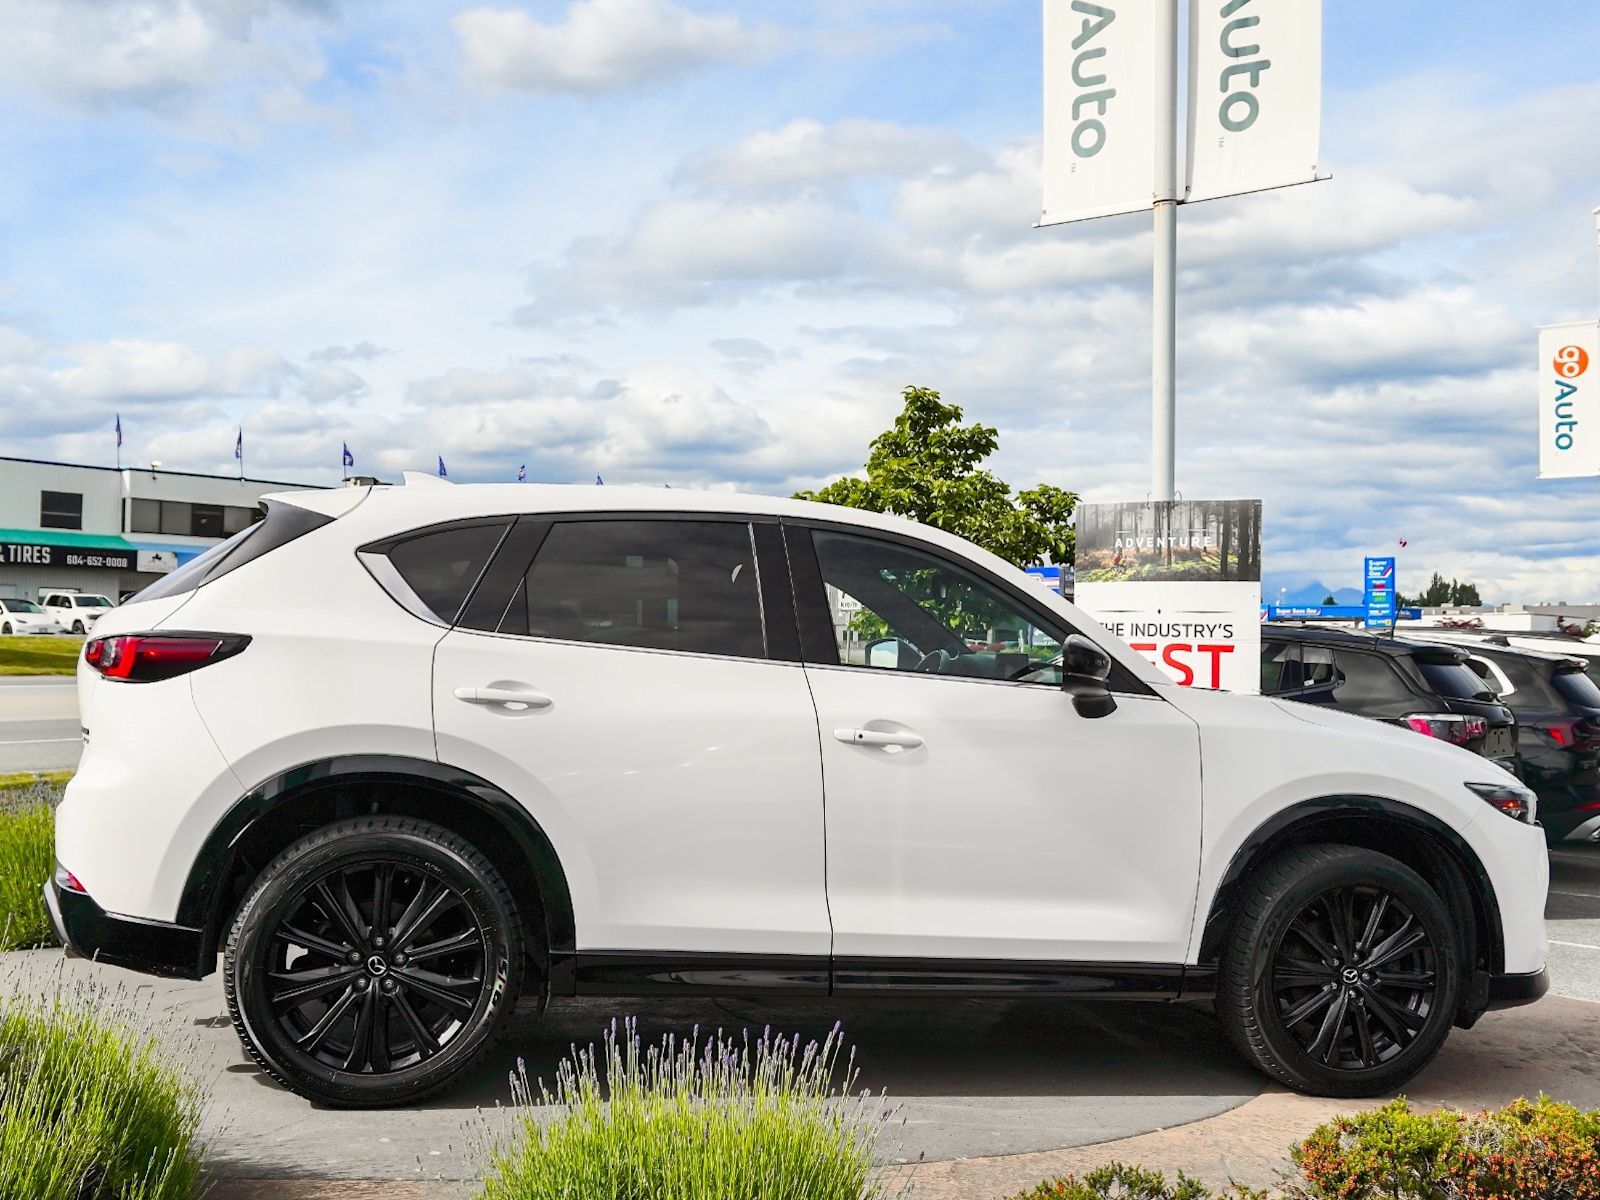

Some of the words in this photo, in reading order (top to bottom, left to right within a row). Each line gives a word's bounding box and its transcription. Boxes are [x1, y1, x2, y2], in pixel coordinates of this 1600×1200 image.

[1071, 0, 1116, 158] Auto
[1555, 380, 1578, 450] Auto
[1115, 536, 1211, 548] ADVENTURE
[8, 544, 50, 563] TIRES
[1100, 622, 1124, 636] HE
[1131, 623, 1233, 639] INDUSTRY'S
